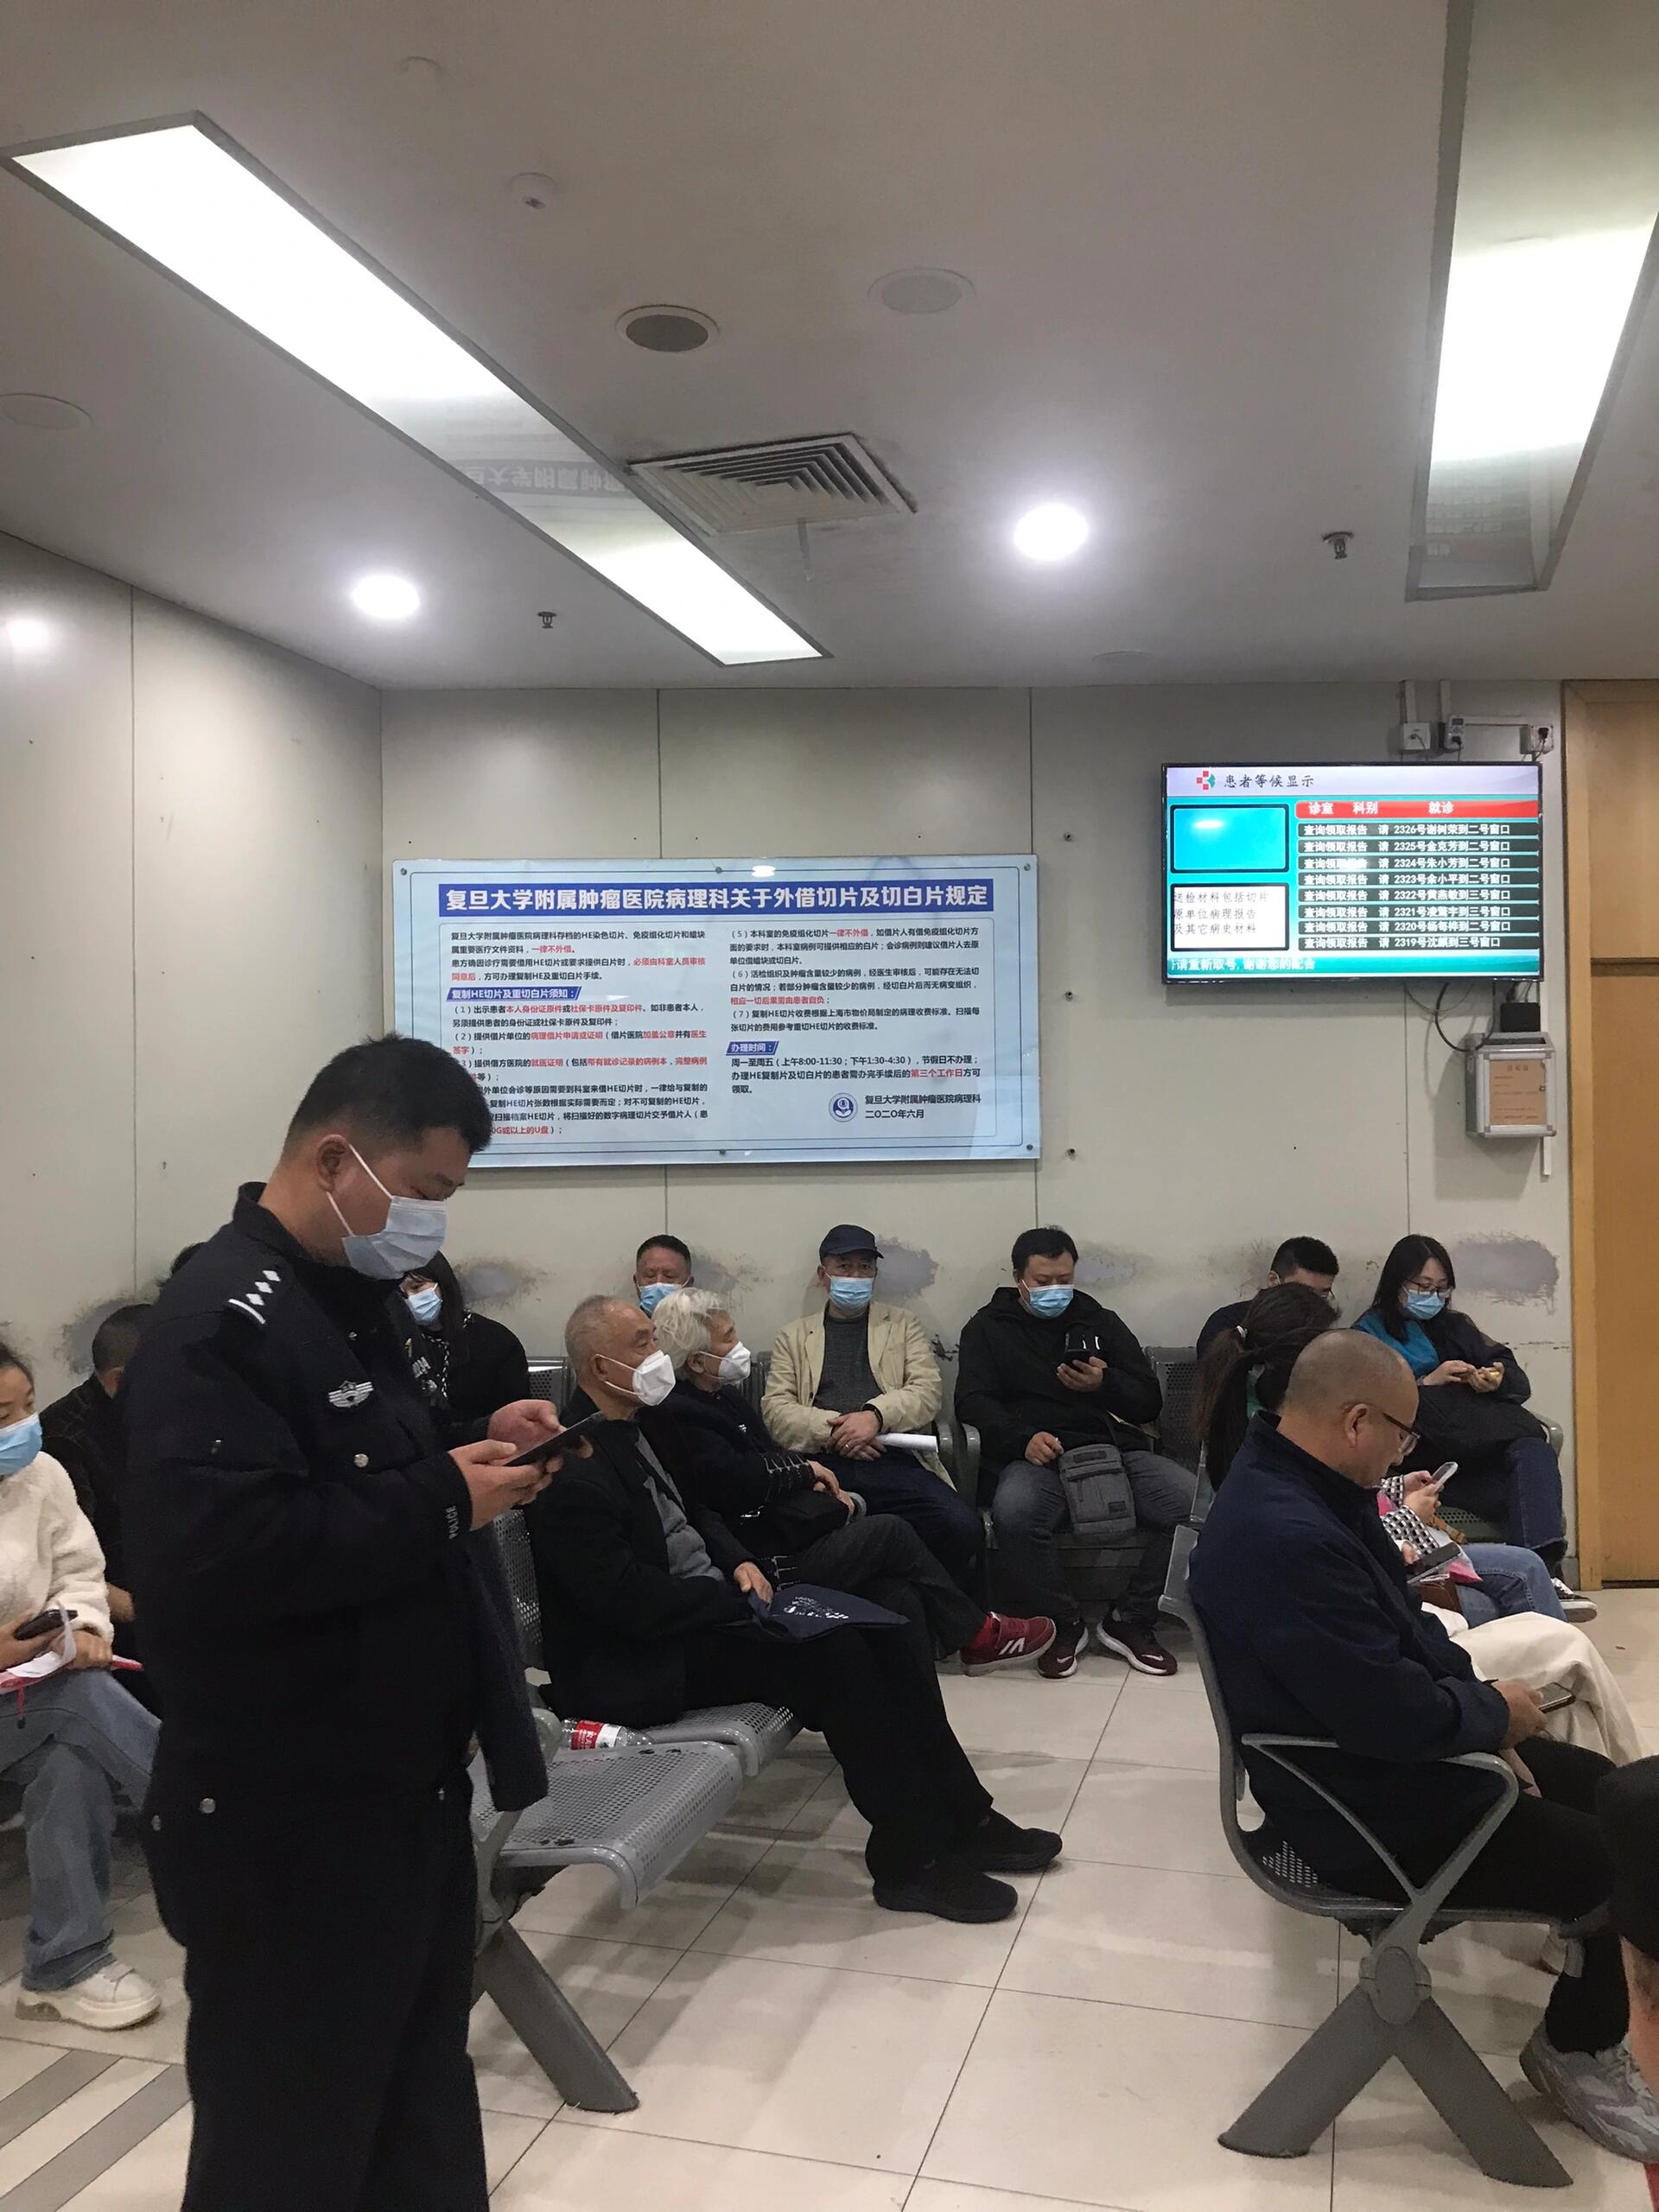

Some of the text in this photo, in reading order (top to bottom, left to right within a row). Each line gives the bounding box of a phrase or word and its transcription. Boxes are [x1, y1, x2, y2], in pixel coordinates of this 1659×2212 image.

[1224, 774, 1314, 788] 患者等候显示
[1308, 801, 1454, 815] 诊室 科别 就诊
[1303, 823, 1368, 836] 查询领取报告
[1377, 823, 1389, 836] 请
[1303, 841, 1368, 852] 查询领取报告
[1377, 841, 1389, 852] 请
[1377, 857, 1389, 869] 请
[1303, 874, 1368, 886] 查询领取报告
[1377, 874, 1389, 886] 请
[446, 885, 988, 912] 复旦大学附属肿瘤医院病理科关于外借切片及切白片规定
[1174, 891, 1268, 904] 送检材料包括切片
[1303, 890, 1368, 901] 查询领取报告
[1377, 889, 1389, 901] 请
[1303, 906, 1368, 918] 查询领取报告
[1377, 906, 1389, 918] 请
[1303, 922, 1368, 933] 查询领取报告
[1377, 921, 1389, 933] 请
[1303, 937, 1368, 949] 查询领取报告
[1377, 937, 1389, 949] 请
[731, 1084, 753, 1095] 领取。
[865, 1094, 982, 1105] 复旦大学附属肿瘤医院病理科
[445, 1505, 460, 1540] POLICE
